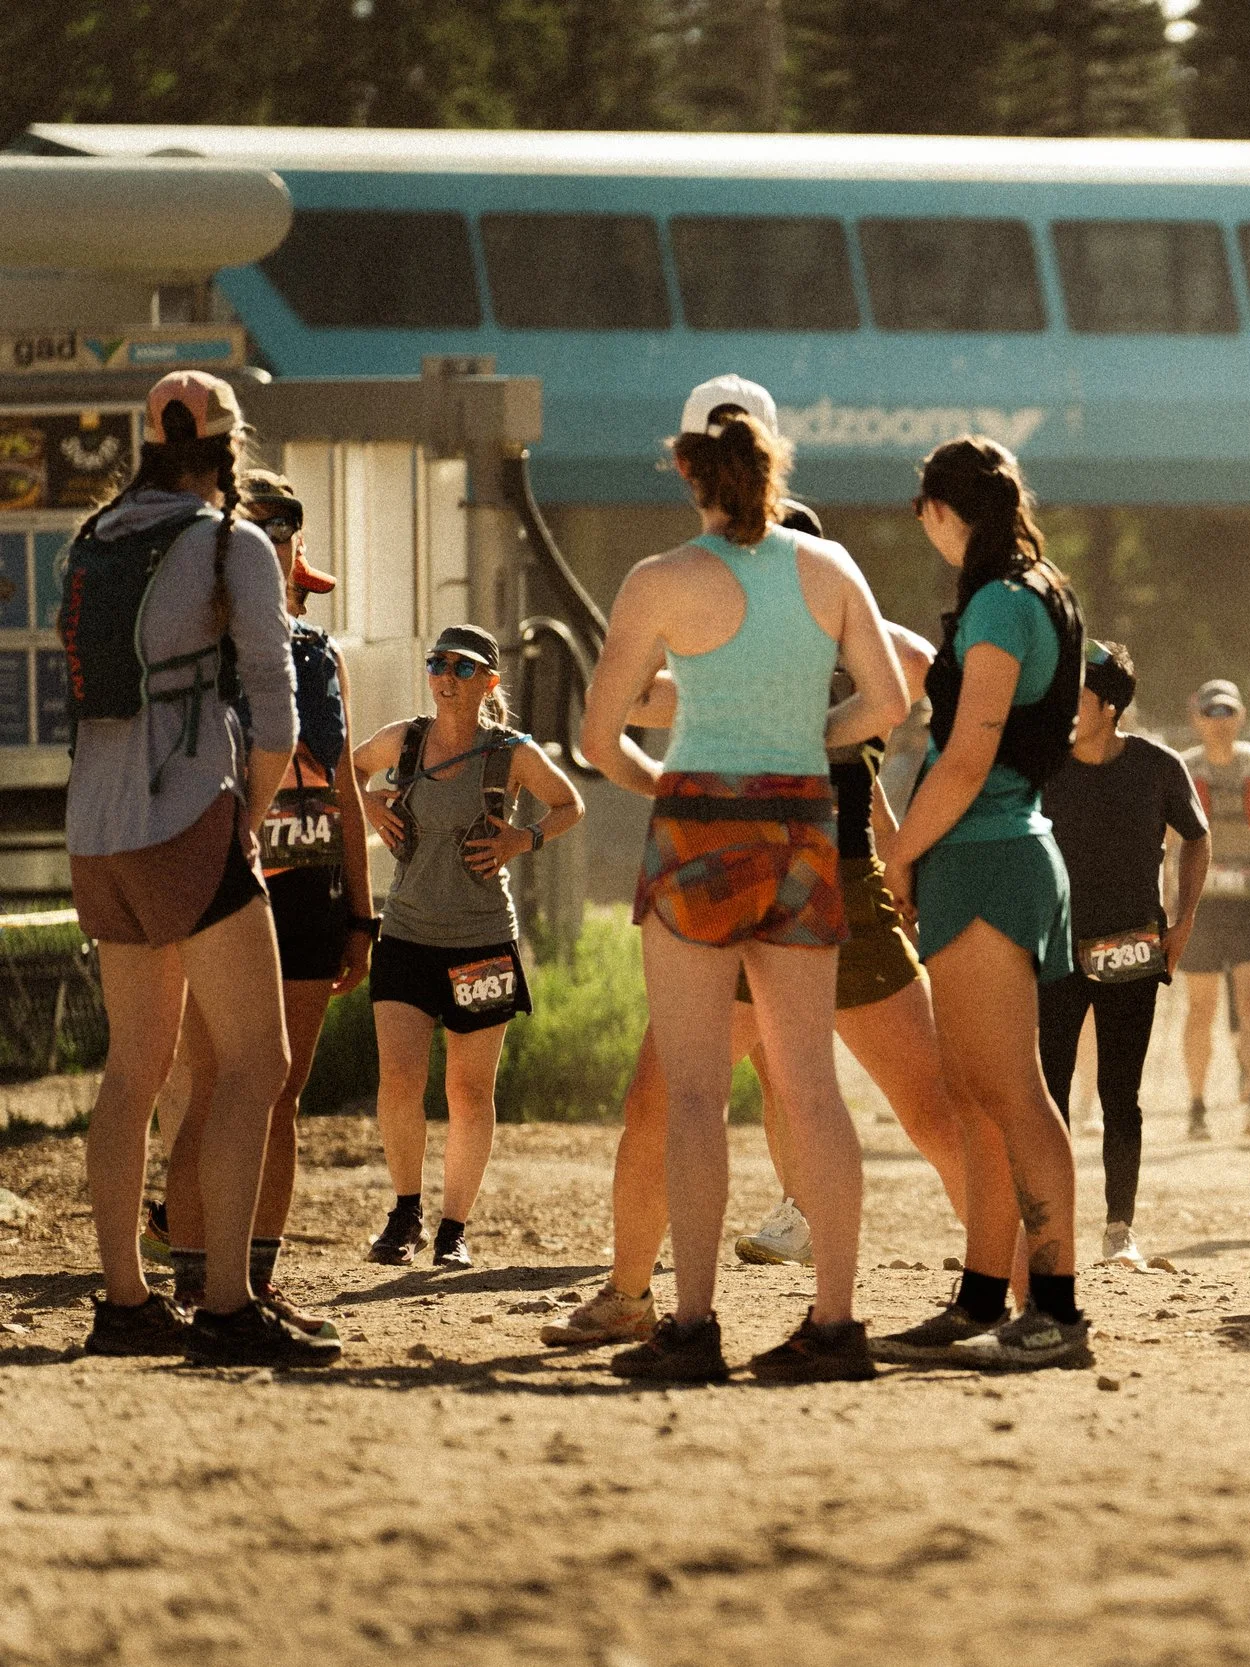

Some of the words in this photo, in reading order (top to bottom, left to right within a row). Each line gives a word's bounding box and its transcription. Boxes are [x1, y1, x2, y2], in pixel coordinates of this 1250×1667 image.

[14, 329, 77, 369] gad
[1091, 941, 1150, 971] 7330
[456, 971, 515, 1006] 8437
